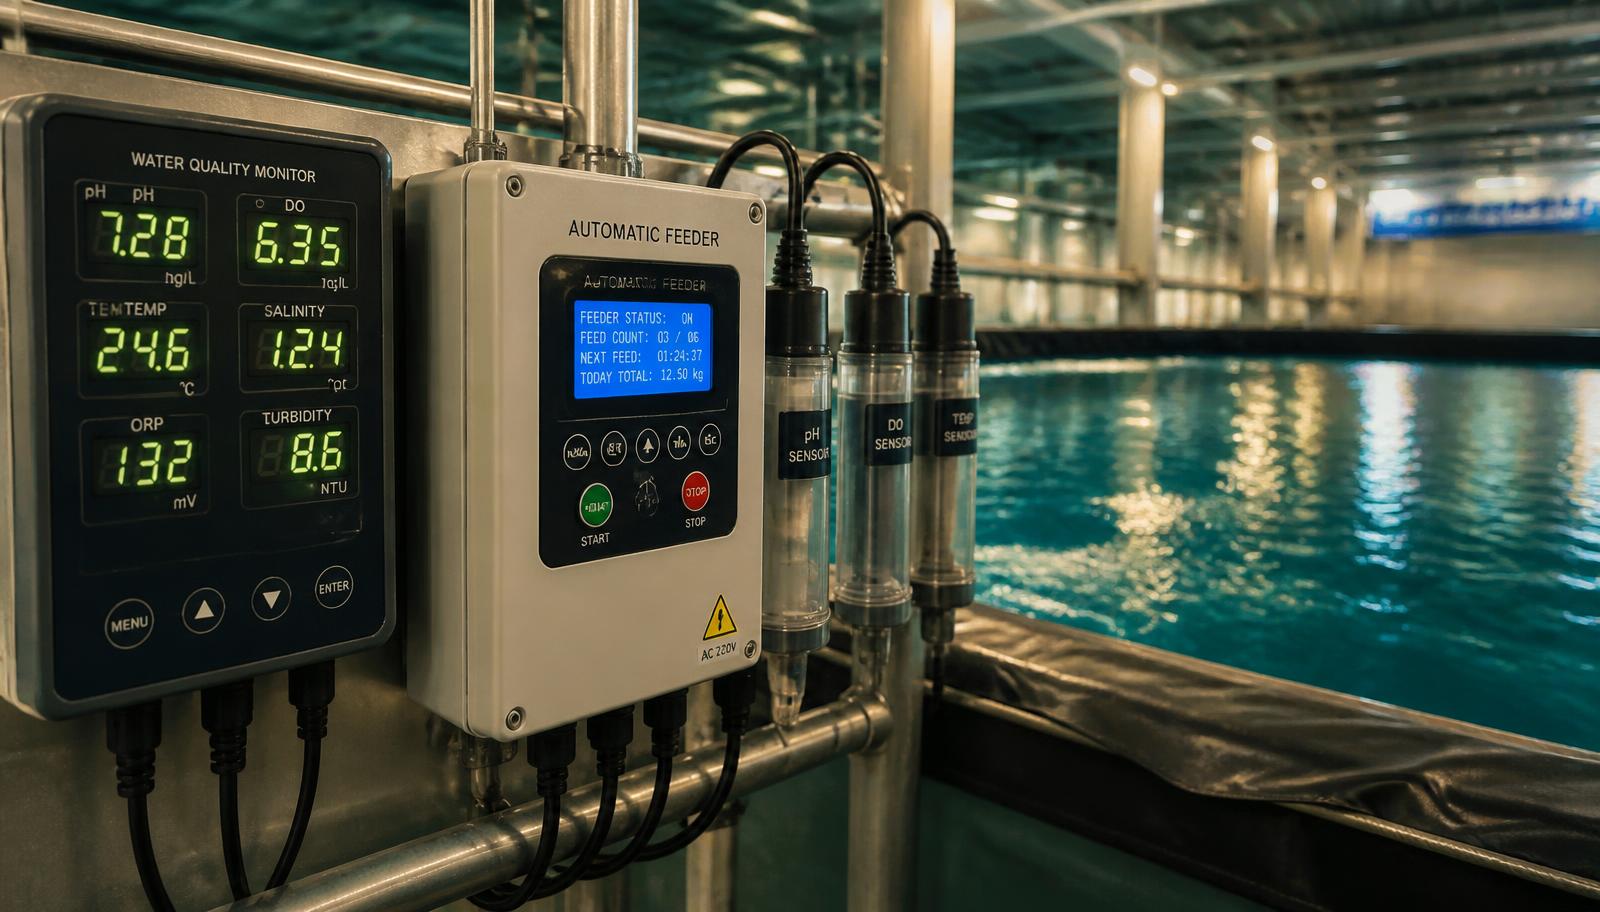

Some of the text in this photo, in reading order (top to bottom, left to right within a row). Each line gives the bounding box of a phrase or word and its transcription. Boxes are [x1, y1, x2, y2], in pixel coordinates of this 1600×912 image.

[131, 152, 316, 183] WATER QUALITY MONITOR
[85, 184, 106, 200] pH
[132, 187, 155, 203] pH
[285, 199, 305, 212] DO
[100, 210, 190, 260] 7.28
[568, 219, 720, 248] AUTOMATIC FEEDER
[254, 221, 340, 267] 6.35
[264, 304, 325, 318] SALINITY
[580, 310, 619, 324] FEEDER
[625, 311, 667, 325] STATUS:
[580, 331, 606, 344] FEED
[612, 331, 649, 344] COUNT:
[657, 331, 669, 343] 03
[97, 327, 190, 373] 24.6
[580, 349, 703, 364] NEXT FEED: 01:24:37
[580, 368, 704, 385] TODAY TOTAL: 12.50 kg
[130, 416, 164, 432] ORP
[262, 408, 332, 425] TURBIDITY
[888, 418, 904, 431] DO
[804, 427, 820, 444] pH
[875, 436, 912, 450] SENSOR
[290, 430, 342, 473] 8.6
[117, 439, 193, 486] 132
[321, 480, 347, 495] NTU
[173, 494, 197, 510] mV
[685, 516, 707, 529] STOP
[581, 532, 610, 547] START
[319, 579, 350, 595] ENTER
[111, 615, 149, 633] MENU
[701, 648, 714, 661] AC
